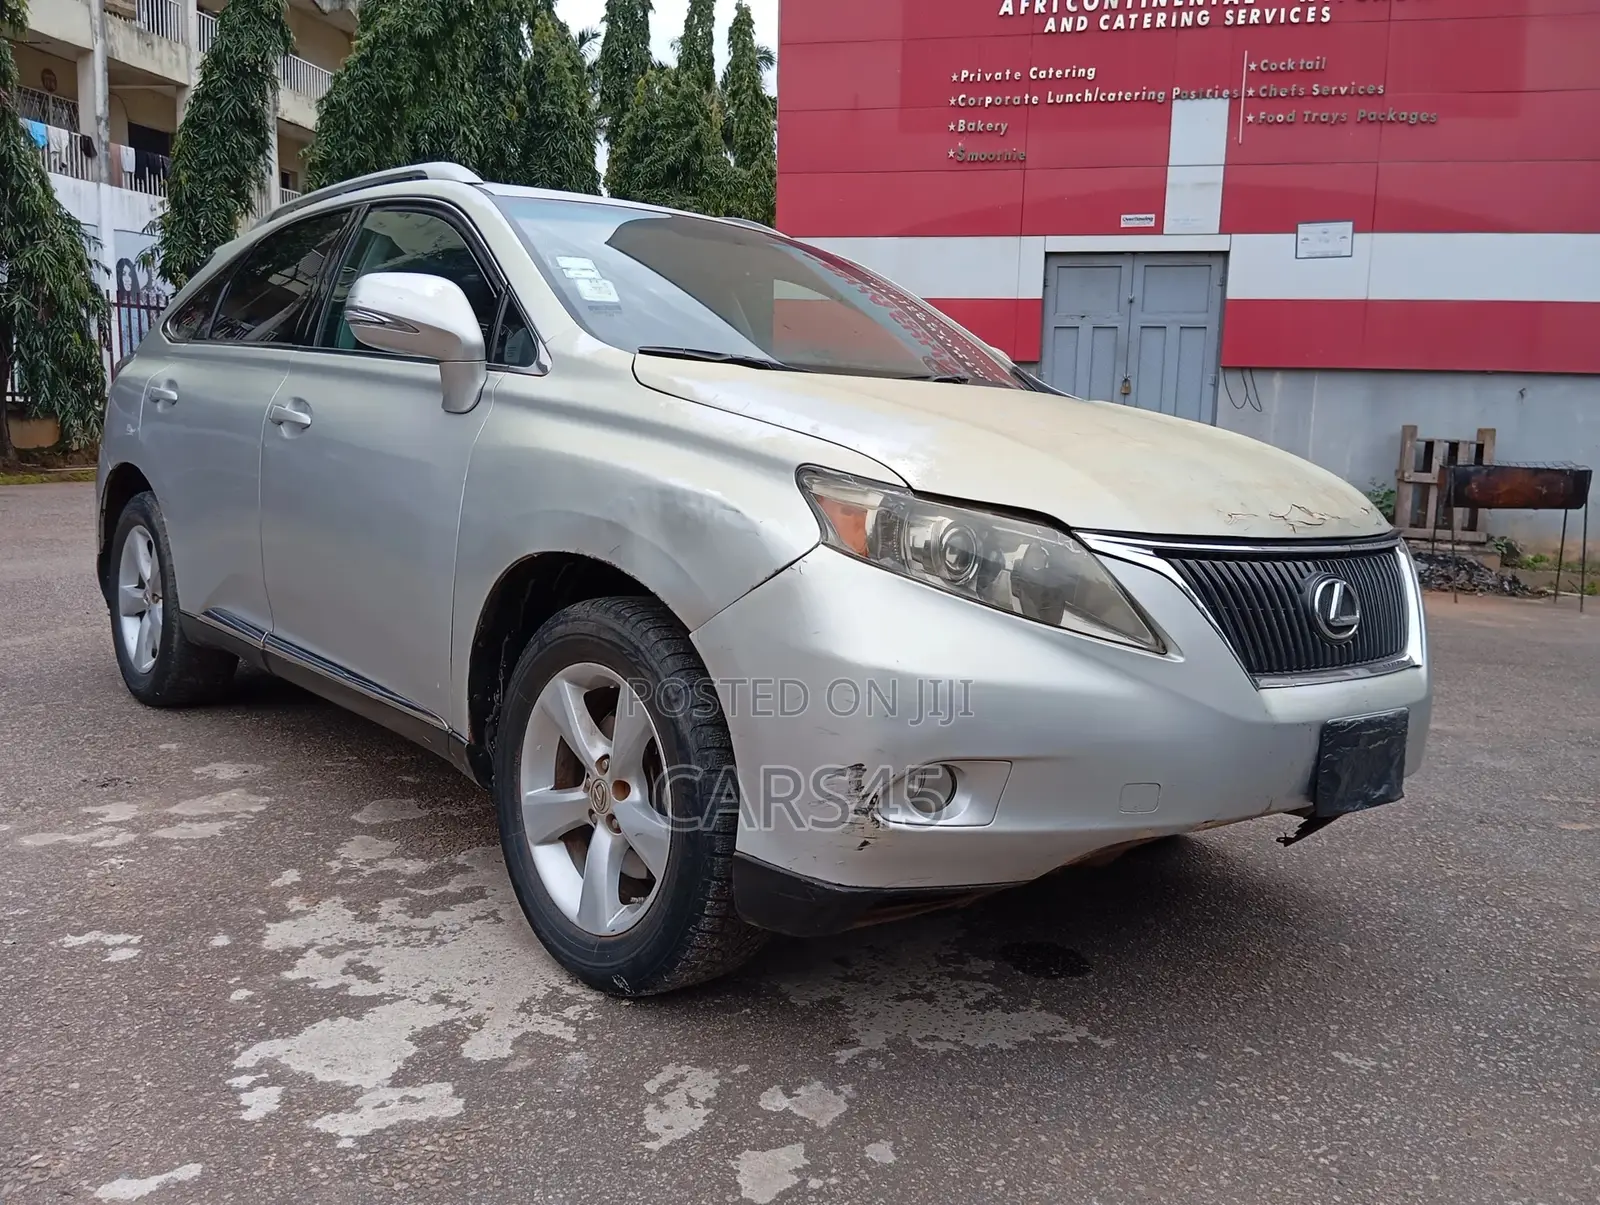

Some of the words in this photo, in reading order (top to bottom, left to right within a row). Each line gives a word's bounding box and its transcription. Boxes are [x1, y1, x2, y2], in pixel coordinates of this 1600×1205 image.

[998, 0, 1255, 16] AFRICONT
[1044, 16, 1089, 33] AND
[1099, 10, 1211, 30] CATERING
[1224, 6, 1331, 26] SERVICES
[1260, 56, 1326, 71] Cocktail
[960, 69, 1022, 82] Private
[1029, 65, 1097, 80] Catering
[1259, 85, 1305, 98] Chefs
[1312, 82, 1385, 96] Services
[958, 92, 1039, 108] Corporate
[1258, 110, 1296, 123] Food
[1303, 110, 1347, 123] Trays
[1357, 107, 1438, 124] Packages
[957, 119, 1008, 135] Bakery
